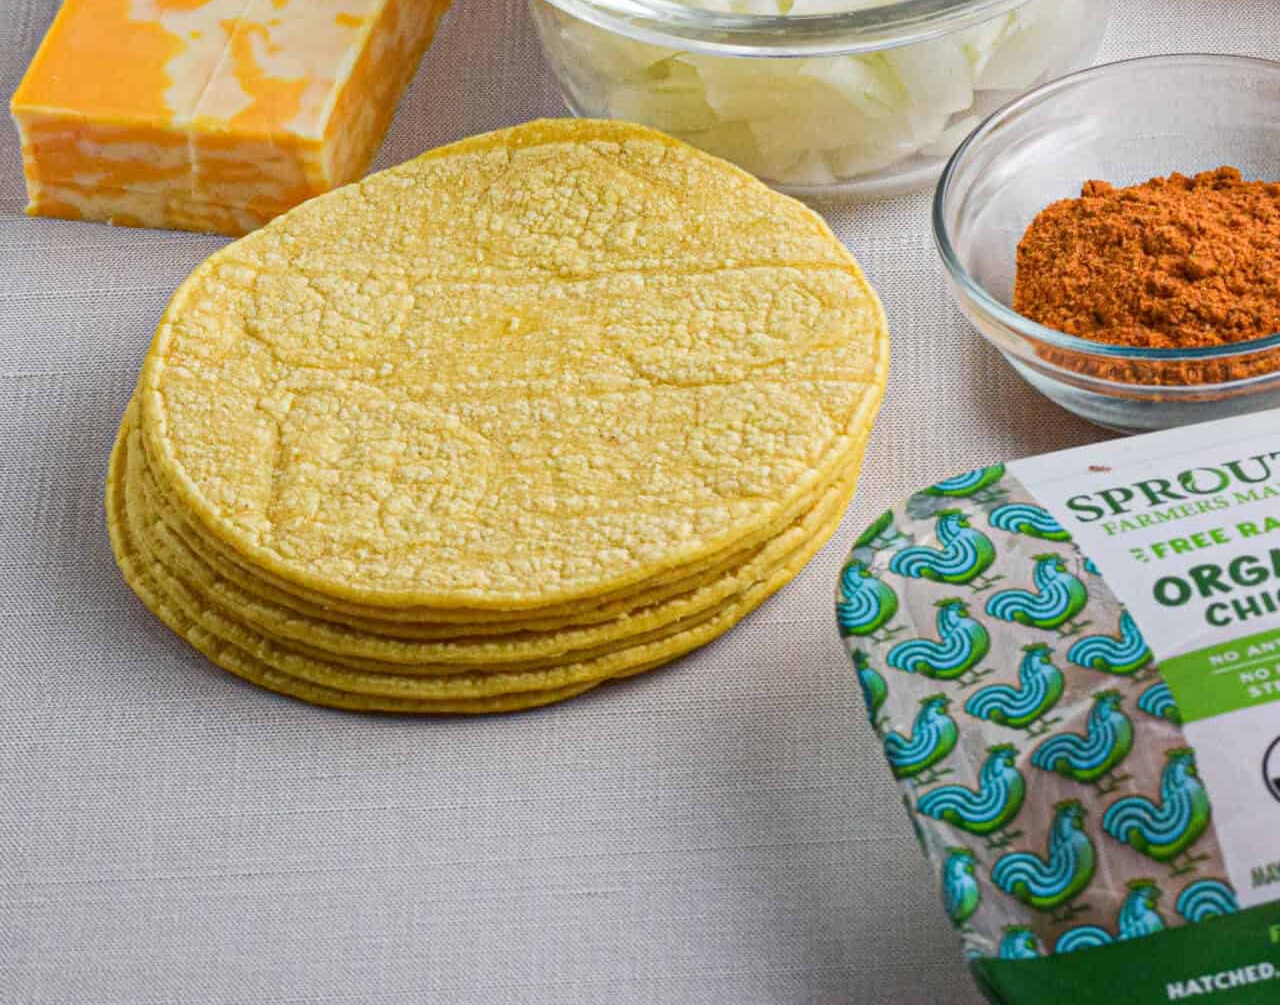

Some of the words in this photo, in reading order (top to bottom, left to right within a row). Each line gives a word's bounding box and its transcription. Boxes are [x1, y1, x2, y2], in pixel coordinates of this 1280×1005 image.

[1102, 494, 1231, 536] FARMERS
[1149, 527, 1232, 560] FREE
[1207, 650, 1240, 666] NO
[1239, 667, 1271, 684] NO
